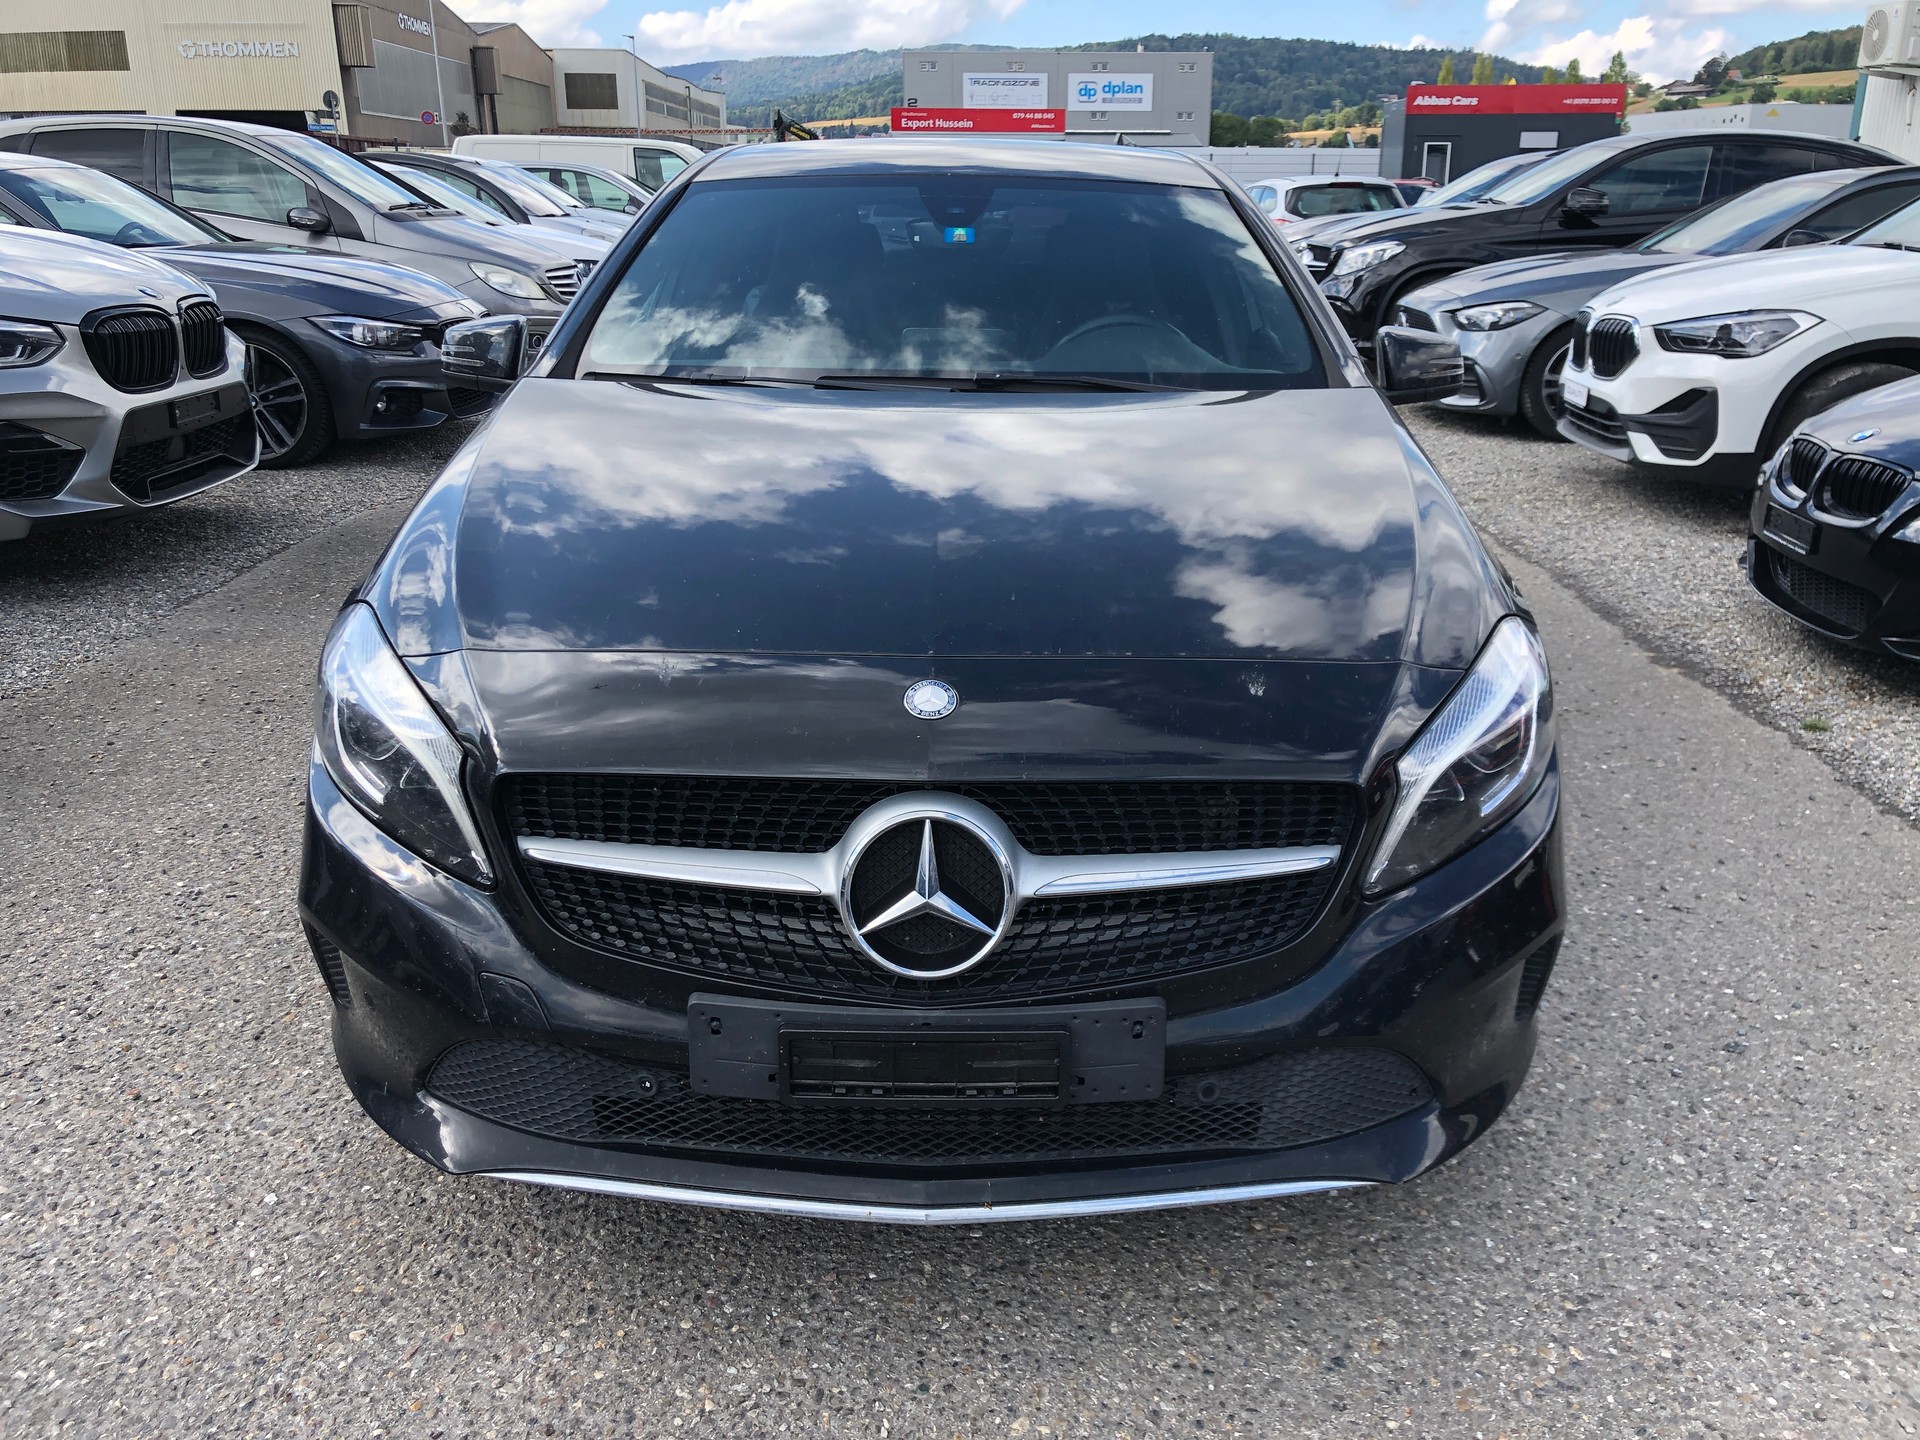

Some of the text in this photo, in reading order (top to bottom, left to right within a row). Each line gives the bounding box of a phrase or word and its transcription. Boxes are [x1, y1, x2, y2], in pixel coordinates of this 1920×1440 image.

[403, 13, 432, 36] THOMMEN
[197, 41, 299, 57] THOMMEN
[1078, 84, 1097, 100] dp
[1102, 80, 1143, 97] dplan
[907, 97, 918, 107] 2
[1413, 95, 1479, 106] Abbas Cars
[901, 118, 974, 130] Export Hussein
